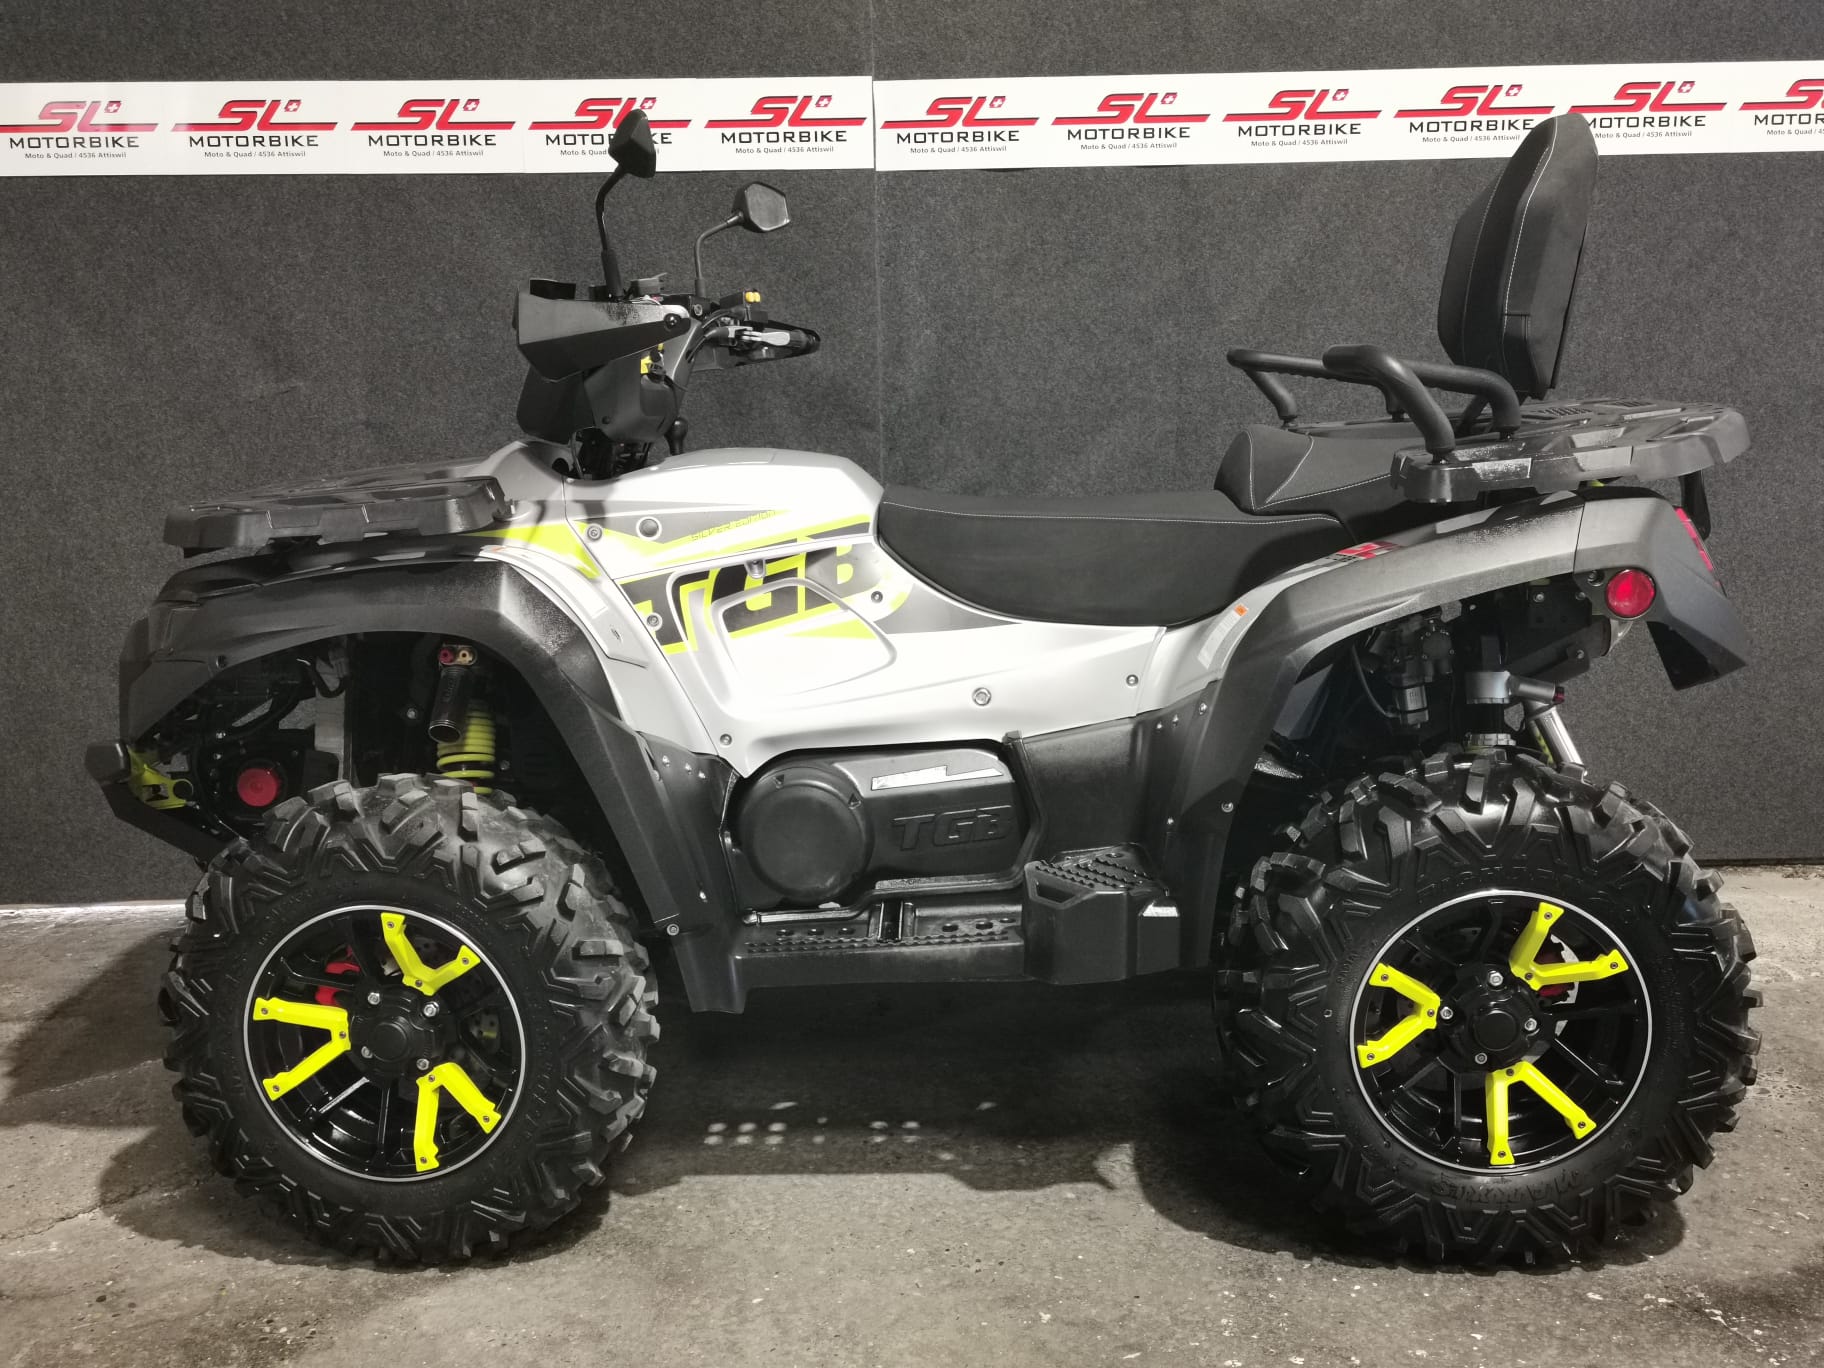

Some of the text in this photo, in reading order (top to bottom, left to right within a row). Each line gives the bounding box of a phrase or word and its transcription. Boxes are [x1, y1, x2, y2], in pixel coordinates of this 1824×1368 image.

[1780, 79, 1824, 110] S
[1238, 123, 1361, 137] MOTORBIKE
[1409, 119, 1534, 133] MOTORBIKE
[189, 135, 319, 147] MOTORBIKE
[368, 134, 496, 147] MOTORBIKE
[545, 132, 673, 146] MOTOKE
[721, 131, 847, 144] MOTORBIKE
[897, 130, 1020, 144] MOTORBIKE
[1067, 127, 1190, 141] MOTORBIKE
[9, 136, 139, 149] MOTORBIKE
[588, 148, 607, 157] Quad
[892, 805, 1014, 850] TGB
